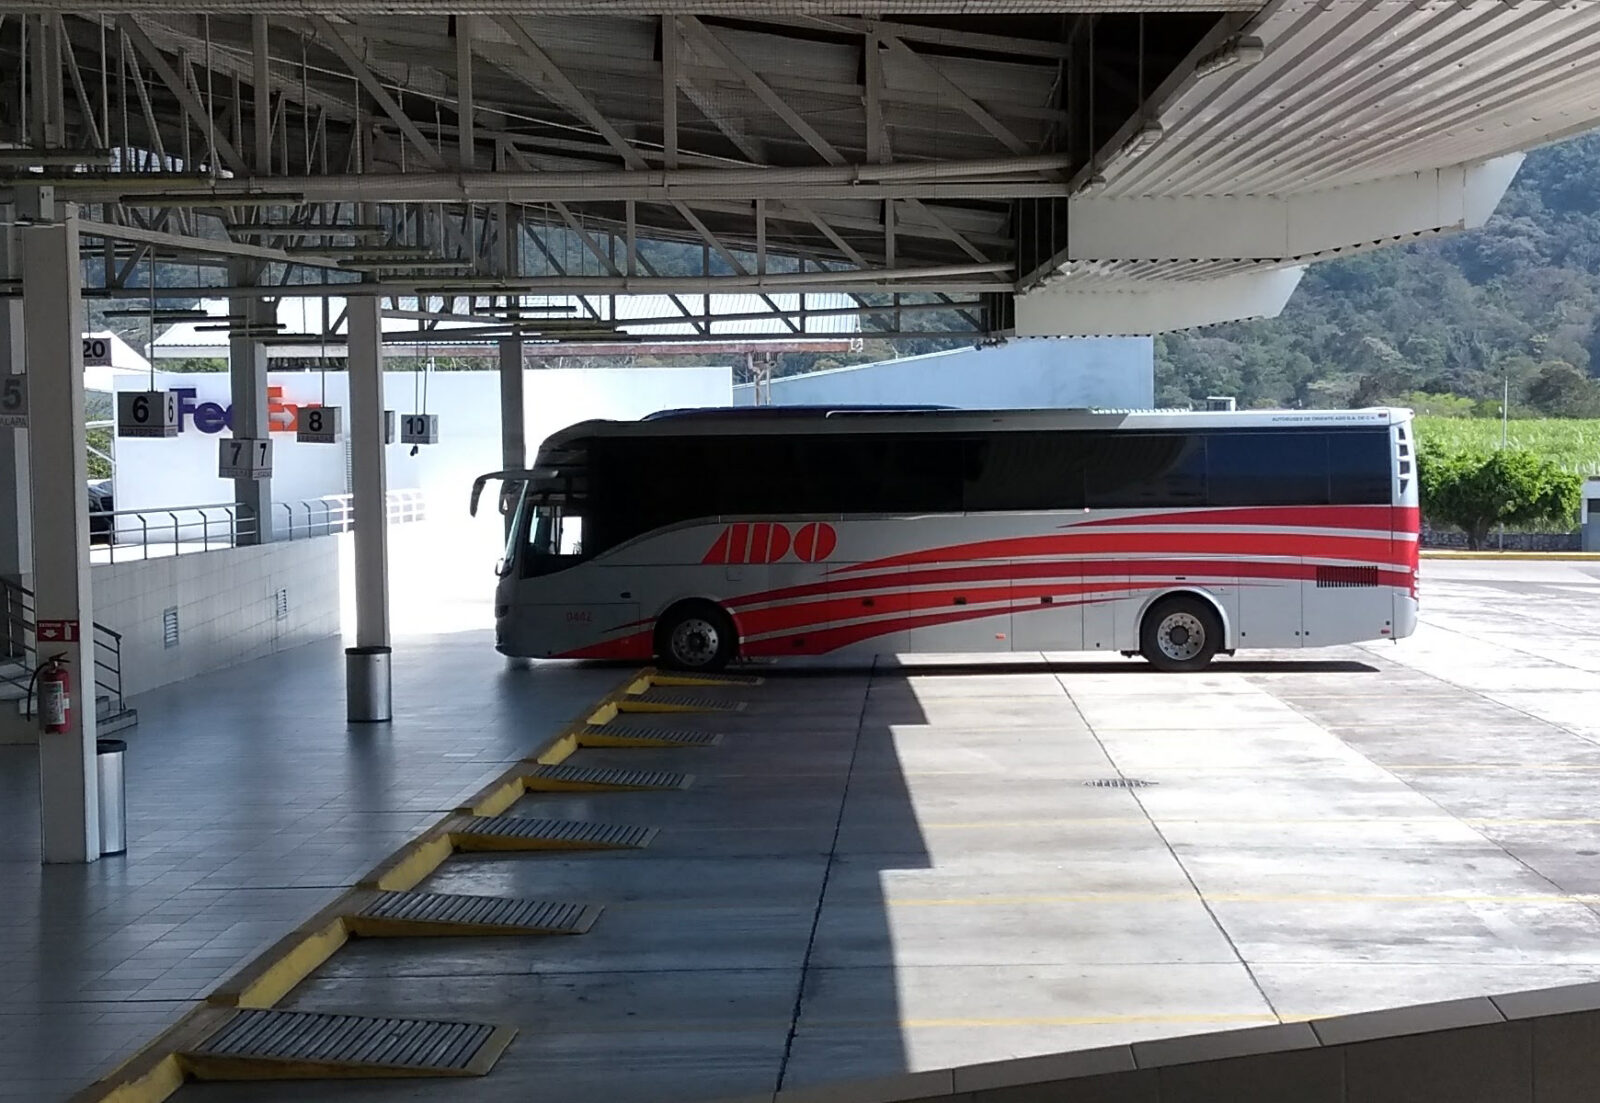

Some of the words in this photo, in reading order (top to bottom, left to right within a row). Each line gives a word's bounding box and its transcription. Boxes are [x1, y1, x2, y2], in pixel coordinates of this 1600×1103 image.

[83, 340, 106, 358] 20
[2, 379, 21, 409] 5
[132, 395, 149, 423] 6
[168, 396, 174, 423] 6
[309, 410, 323, 432] 8
[406, 417, 425, 435] 10
[230, 442, 242, 466] 7
[260, 442, 267, 466] 7
[701, 522, 837, 564] ADO
